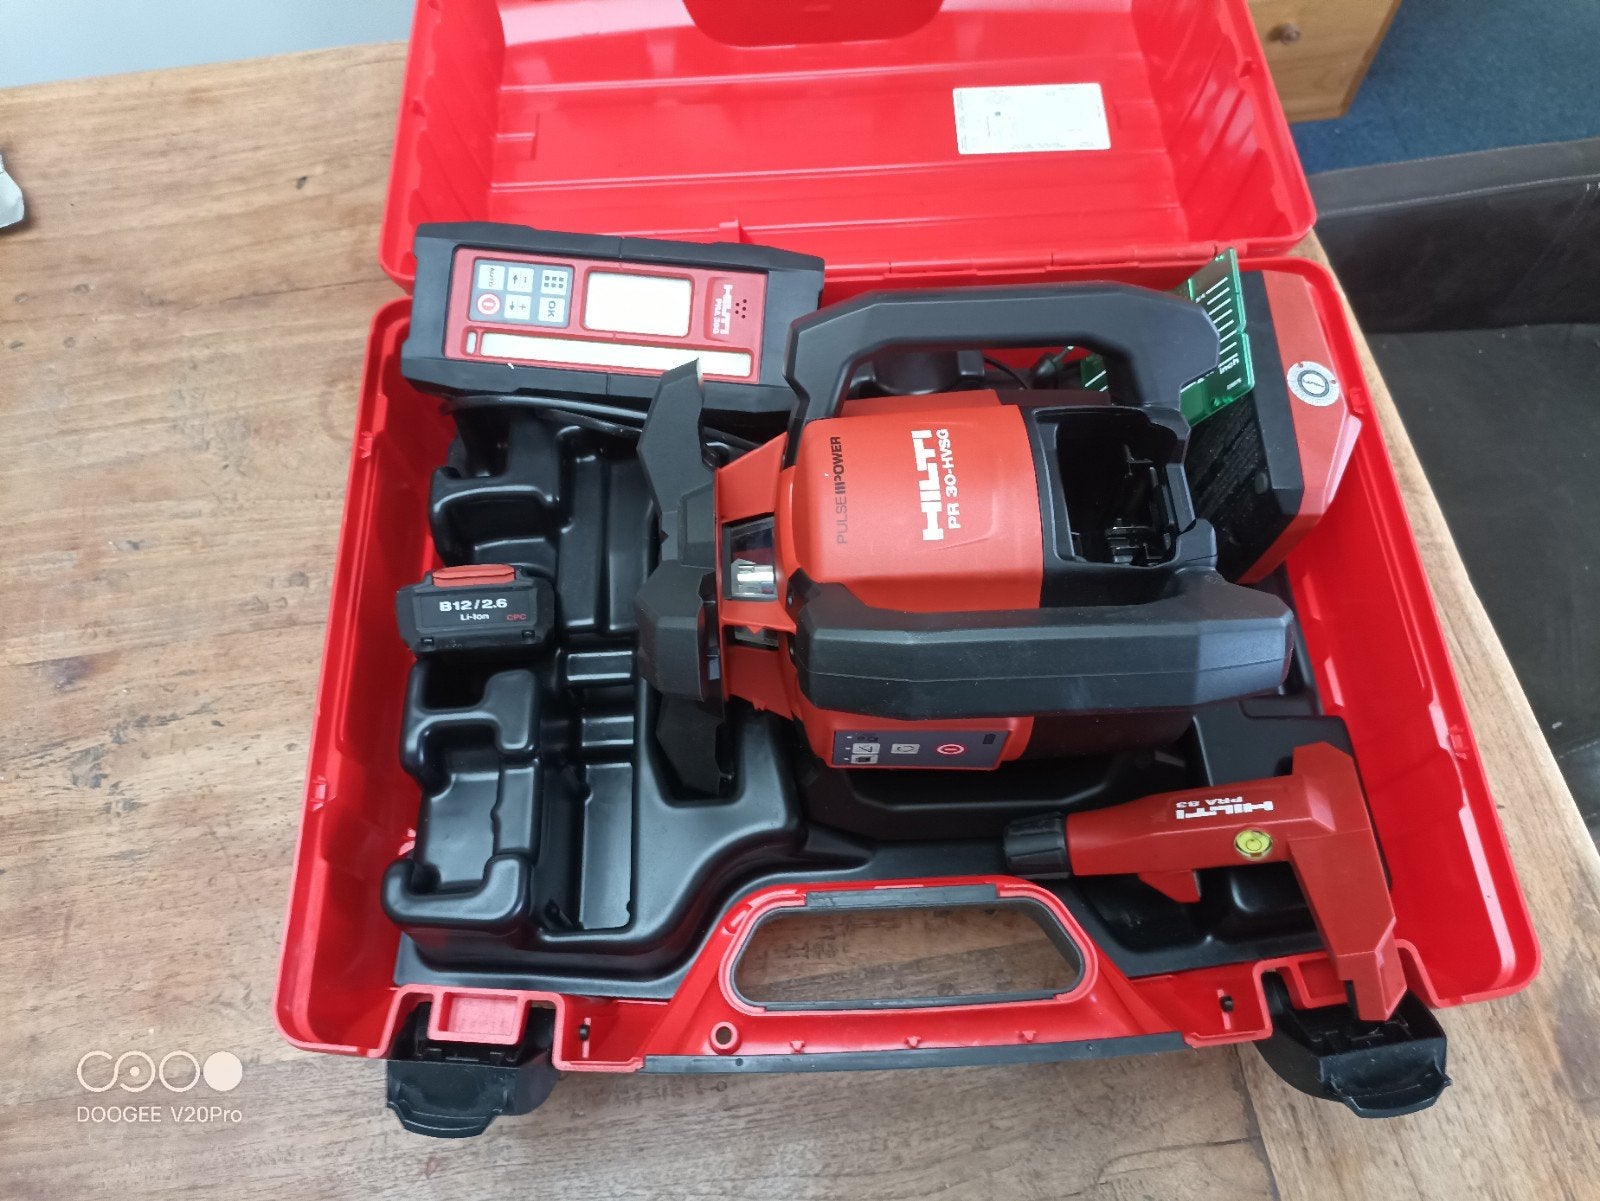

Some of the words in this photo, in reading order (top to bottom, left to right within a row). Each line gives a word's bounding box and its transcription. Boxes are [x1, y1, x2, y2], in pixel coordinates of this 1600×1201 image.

[547, 300, 556, 318] OK
[720, 284, 733, 335] HILTI
[935, 428, 958, 498] 30-HVSG
[911, 429, 944, 541] HILTI
[835, 496, 848, 545] PULSE
[946, 502, 961, 529] PR
[439, 598, 508, 612] B12/2.6
[459, 613, 490, 621] Li-Ion
[506, 613, 527, 621] CPC
[1175, 801, 1200, 809] 83
[1175, 801, 1274, 819] HILTI
[1204, 796, 1243, 806] PRA
